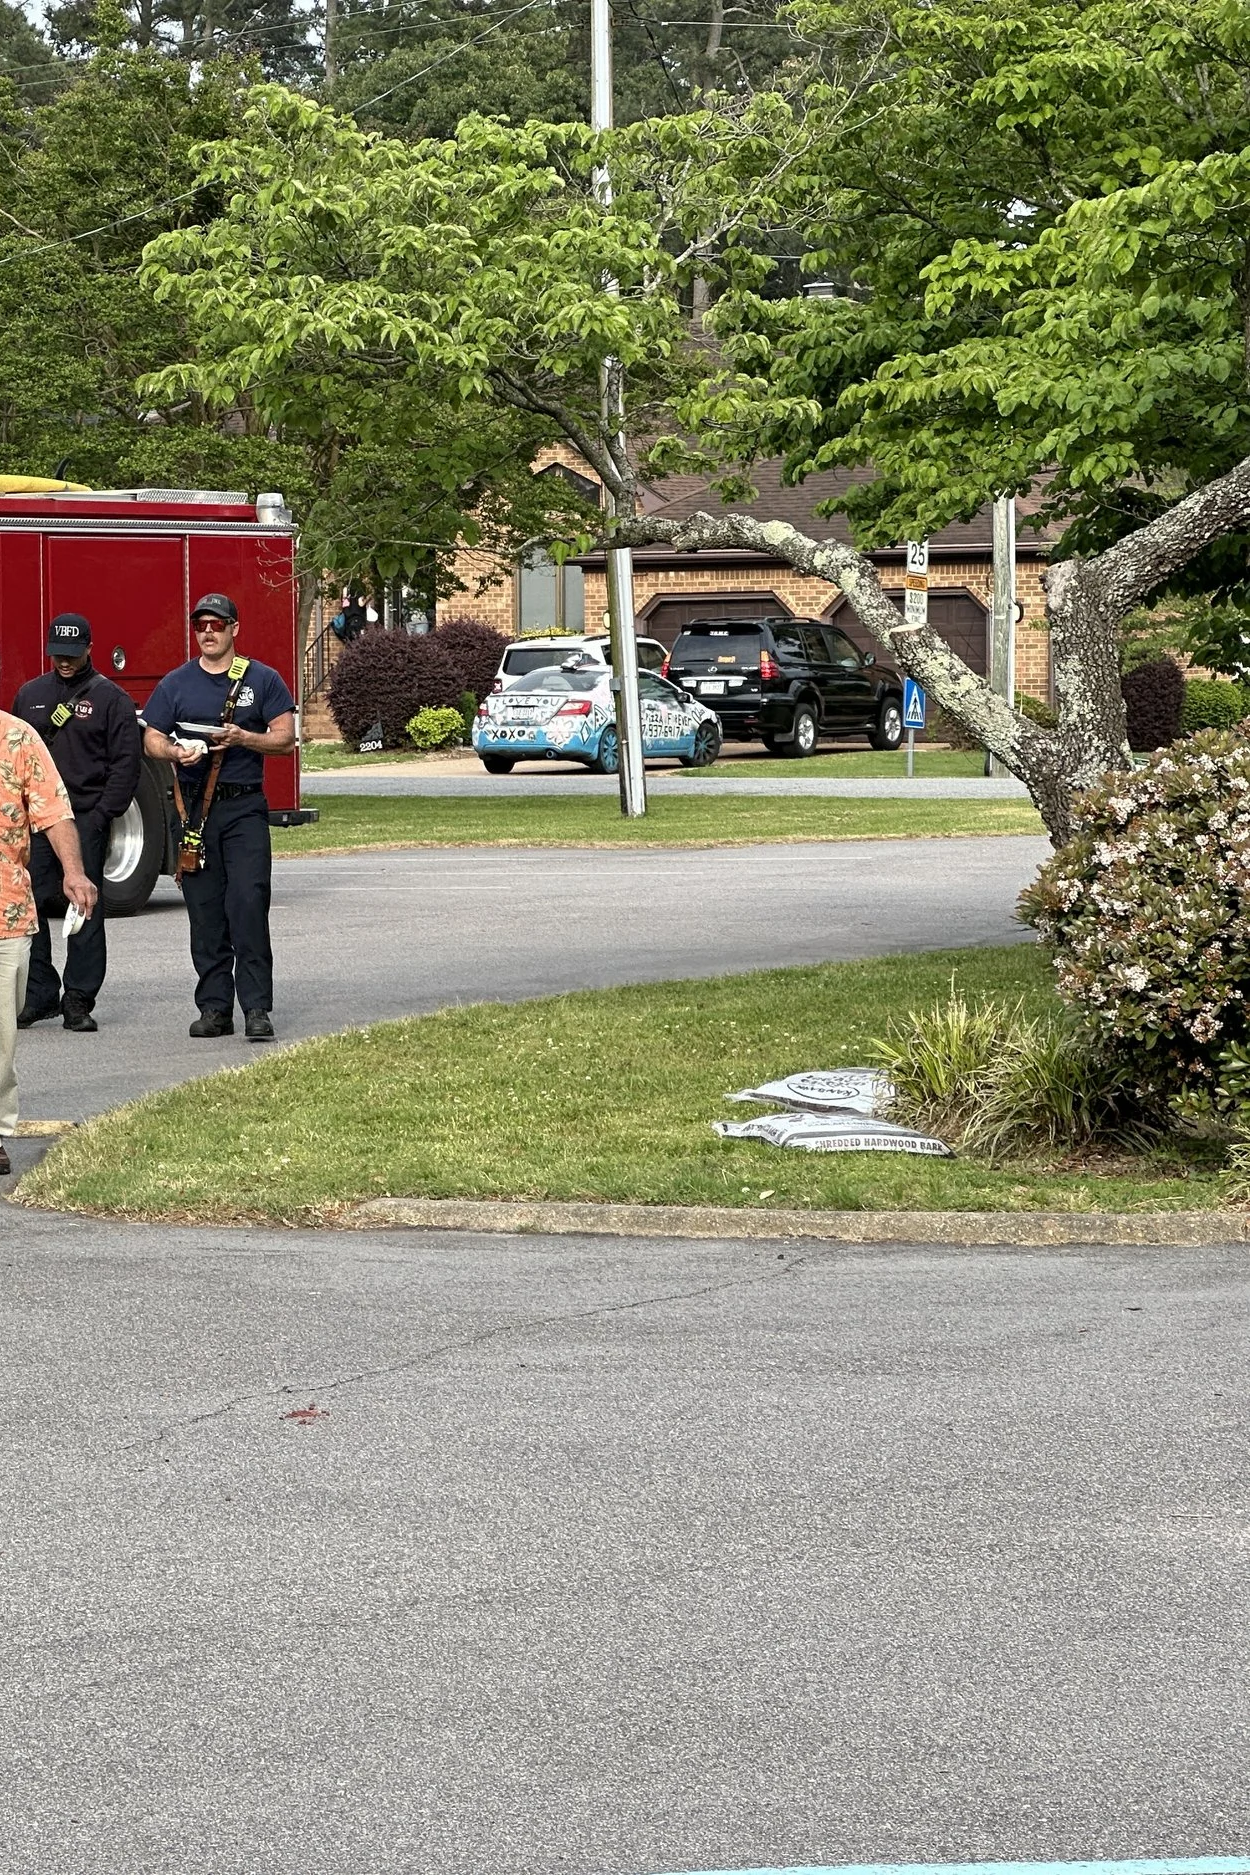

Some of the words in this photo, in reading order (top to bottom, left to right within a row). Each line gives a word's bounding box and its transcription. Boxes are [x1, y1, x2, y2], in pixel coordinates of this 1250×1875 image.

[910, 543, 925, 566] 25
[909, 592, 924, 605] $200
[54, 625, 80, 637] VBFD
[502, 697, 530, 705] LOVE
[536, 697, 561, 706] YOU
[360, 740, 383, 752] 2204
[815, 1138, 861, 1149] SHREDDED
[864, 1138, 917, 1149] HARDWOOD
[920, 1141, 943, 1152] BARK
